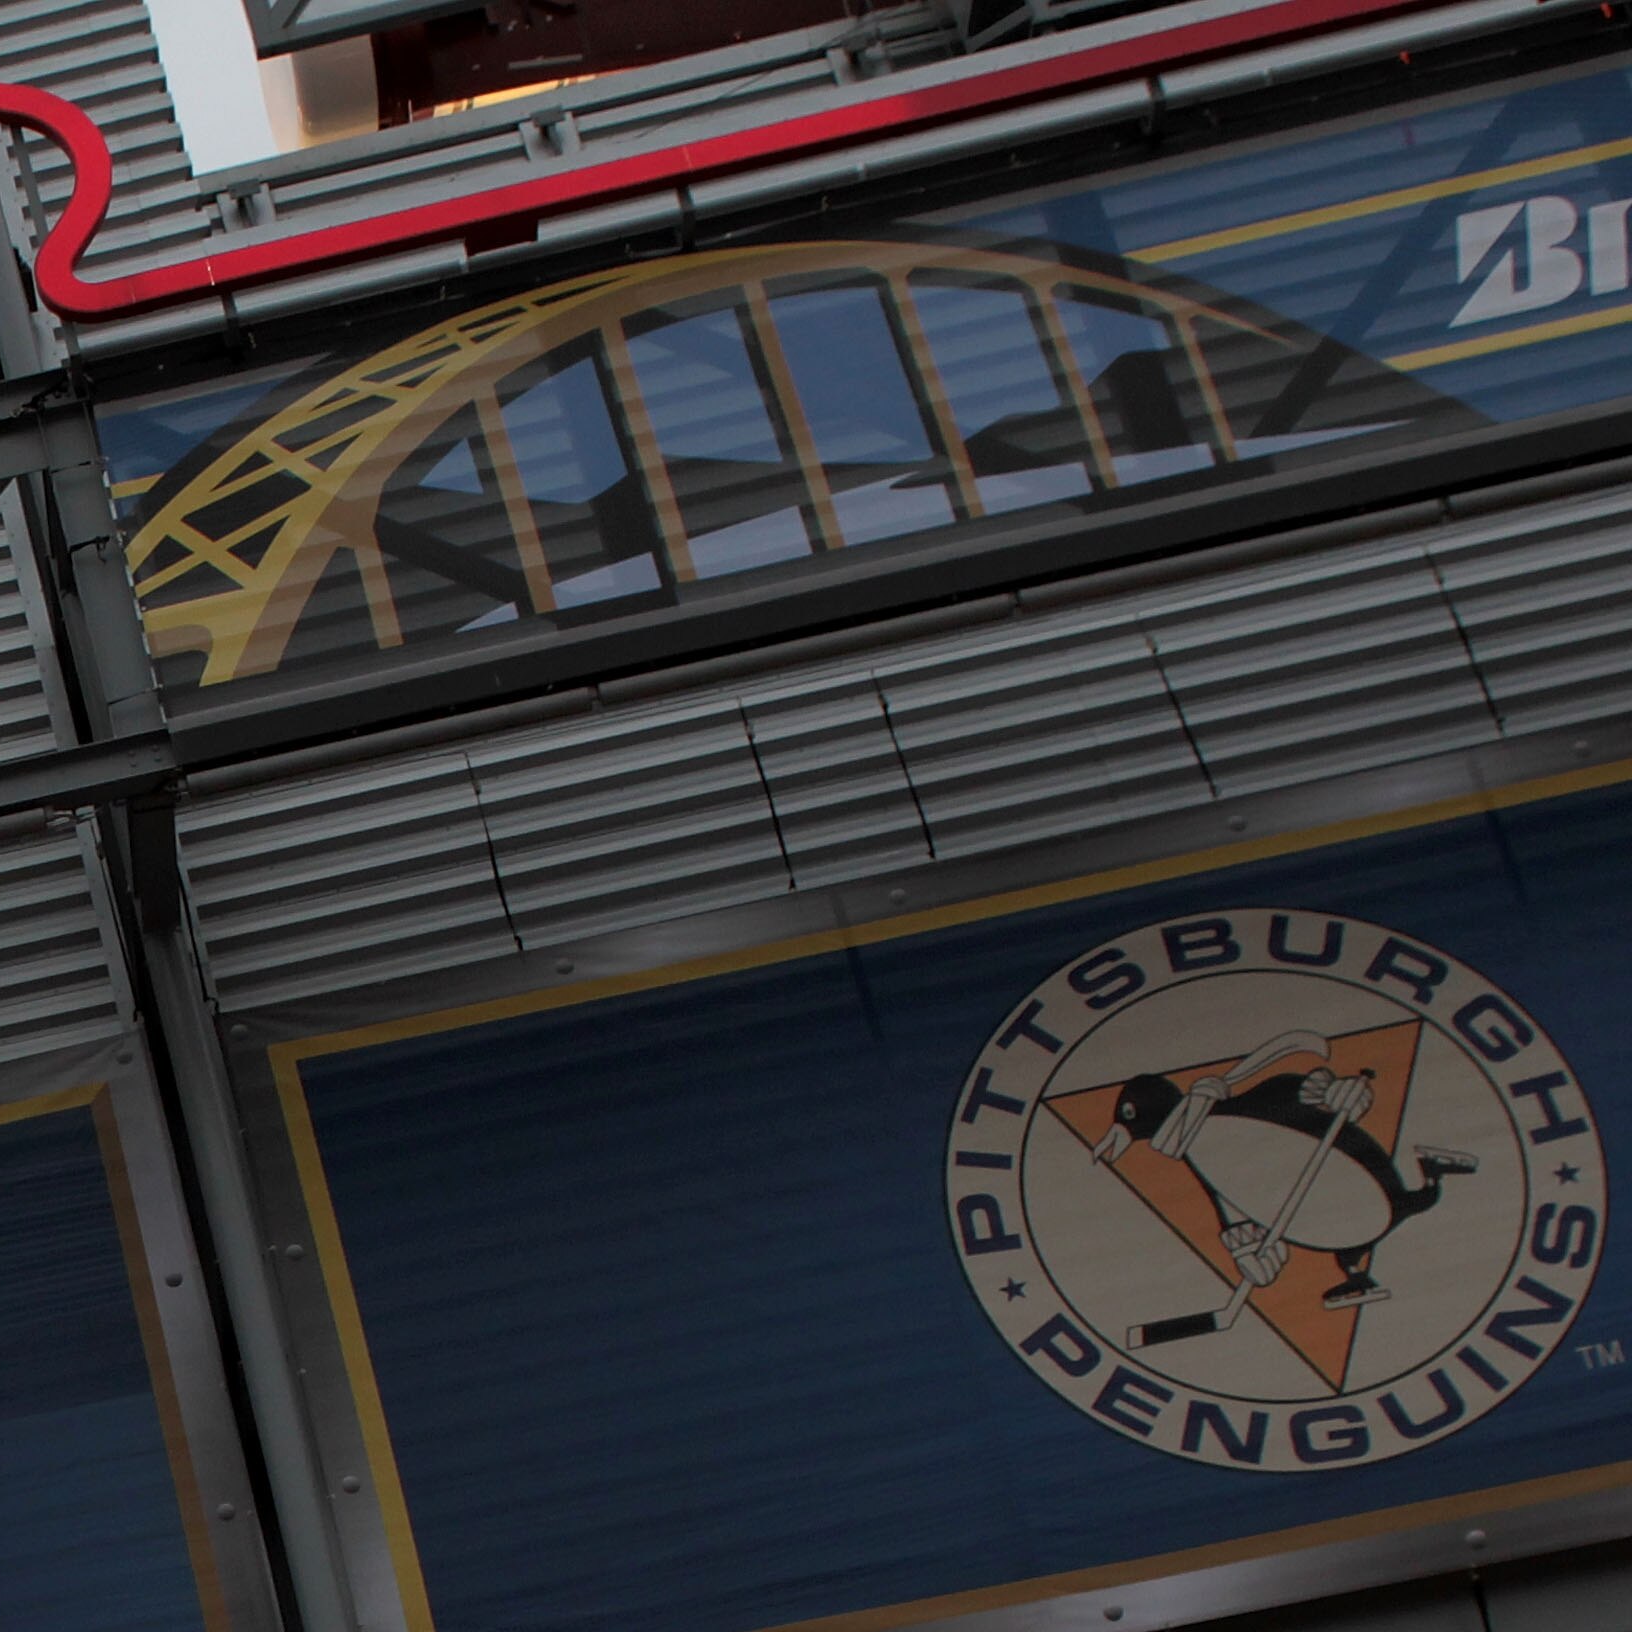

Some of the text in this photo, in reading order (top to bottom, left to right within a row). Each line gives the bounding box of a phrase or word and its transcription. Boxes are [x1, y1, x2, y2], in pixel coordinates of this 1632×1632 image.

[955, 913, 1592, 1257] PITTSBURGH
[1018, 1201, 1599, 1466] PENGUINS
[1574, 1340, 1626, 1370] TM
